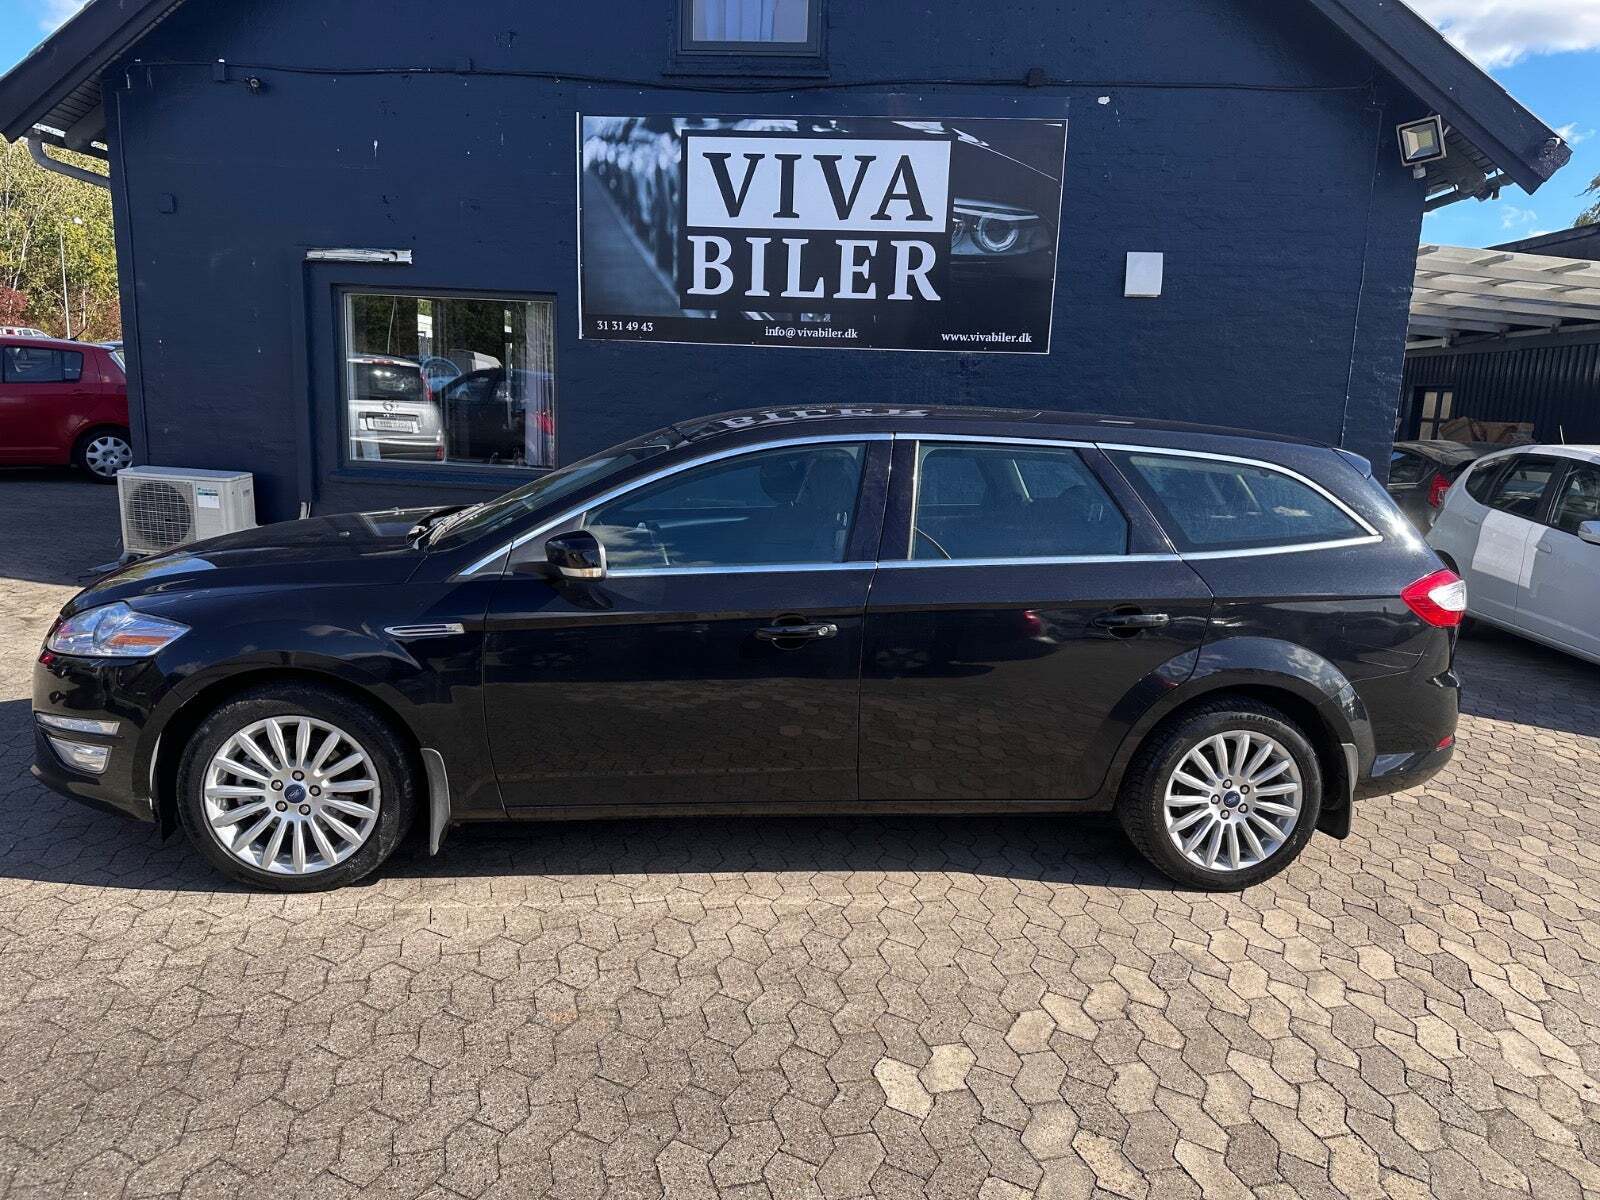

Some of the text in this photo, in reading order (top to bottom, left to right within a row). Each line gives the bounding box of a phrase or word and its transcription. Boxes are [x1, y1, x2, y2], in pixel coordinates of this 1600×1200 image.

[702, 152, 934, 221] VIVA
[686, 235, 942, 301] BILER
[597, 320, 654, 332] 31 31 49 43
[941, 332, 1033, 343] www.vivabiler.dk
